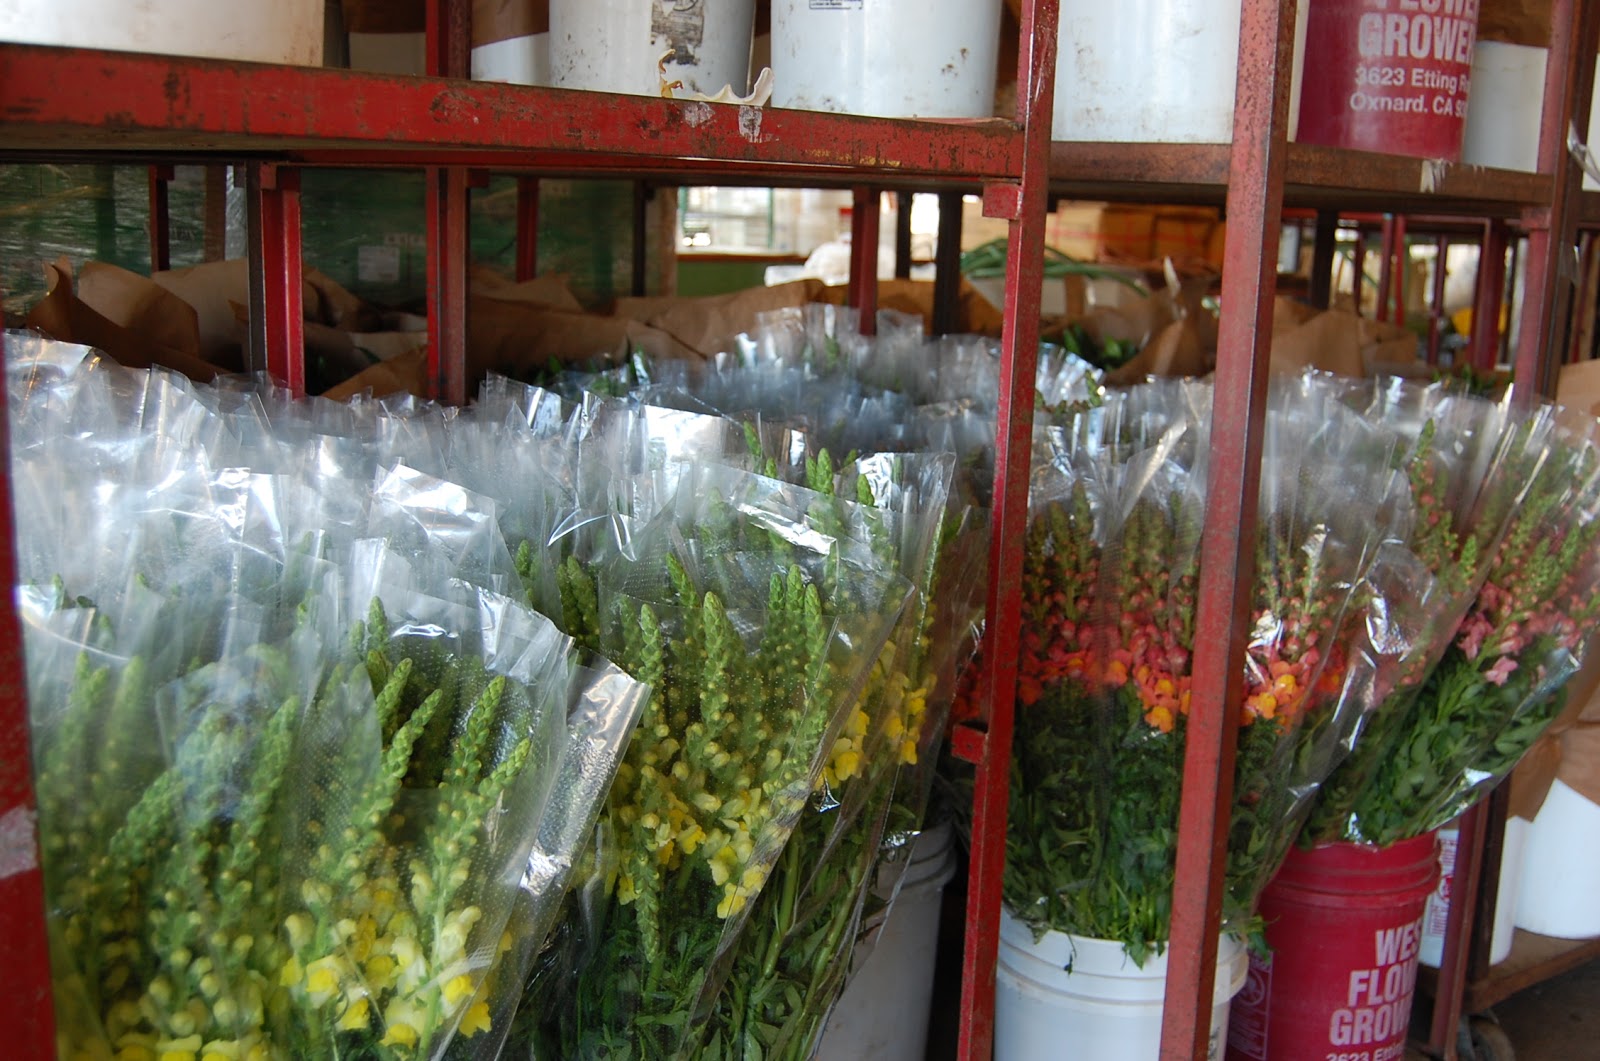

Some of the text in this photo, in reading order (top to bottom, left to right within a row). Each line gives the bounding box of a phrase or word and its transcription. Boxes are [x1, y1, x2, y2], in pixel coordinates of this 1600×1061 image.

[1355, 66, 1405, 86] 3623
[1411, 68, 1458, 95] Etting
[1432, 95, 1453, 116] CA
